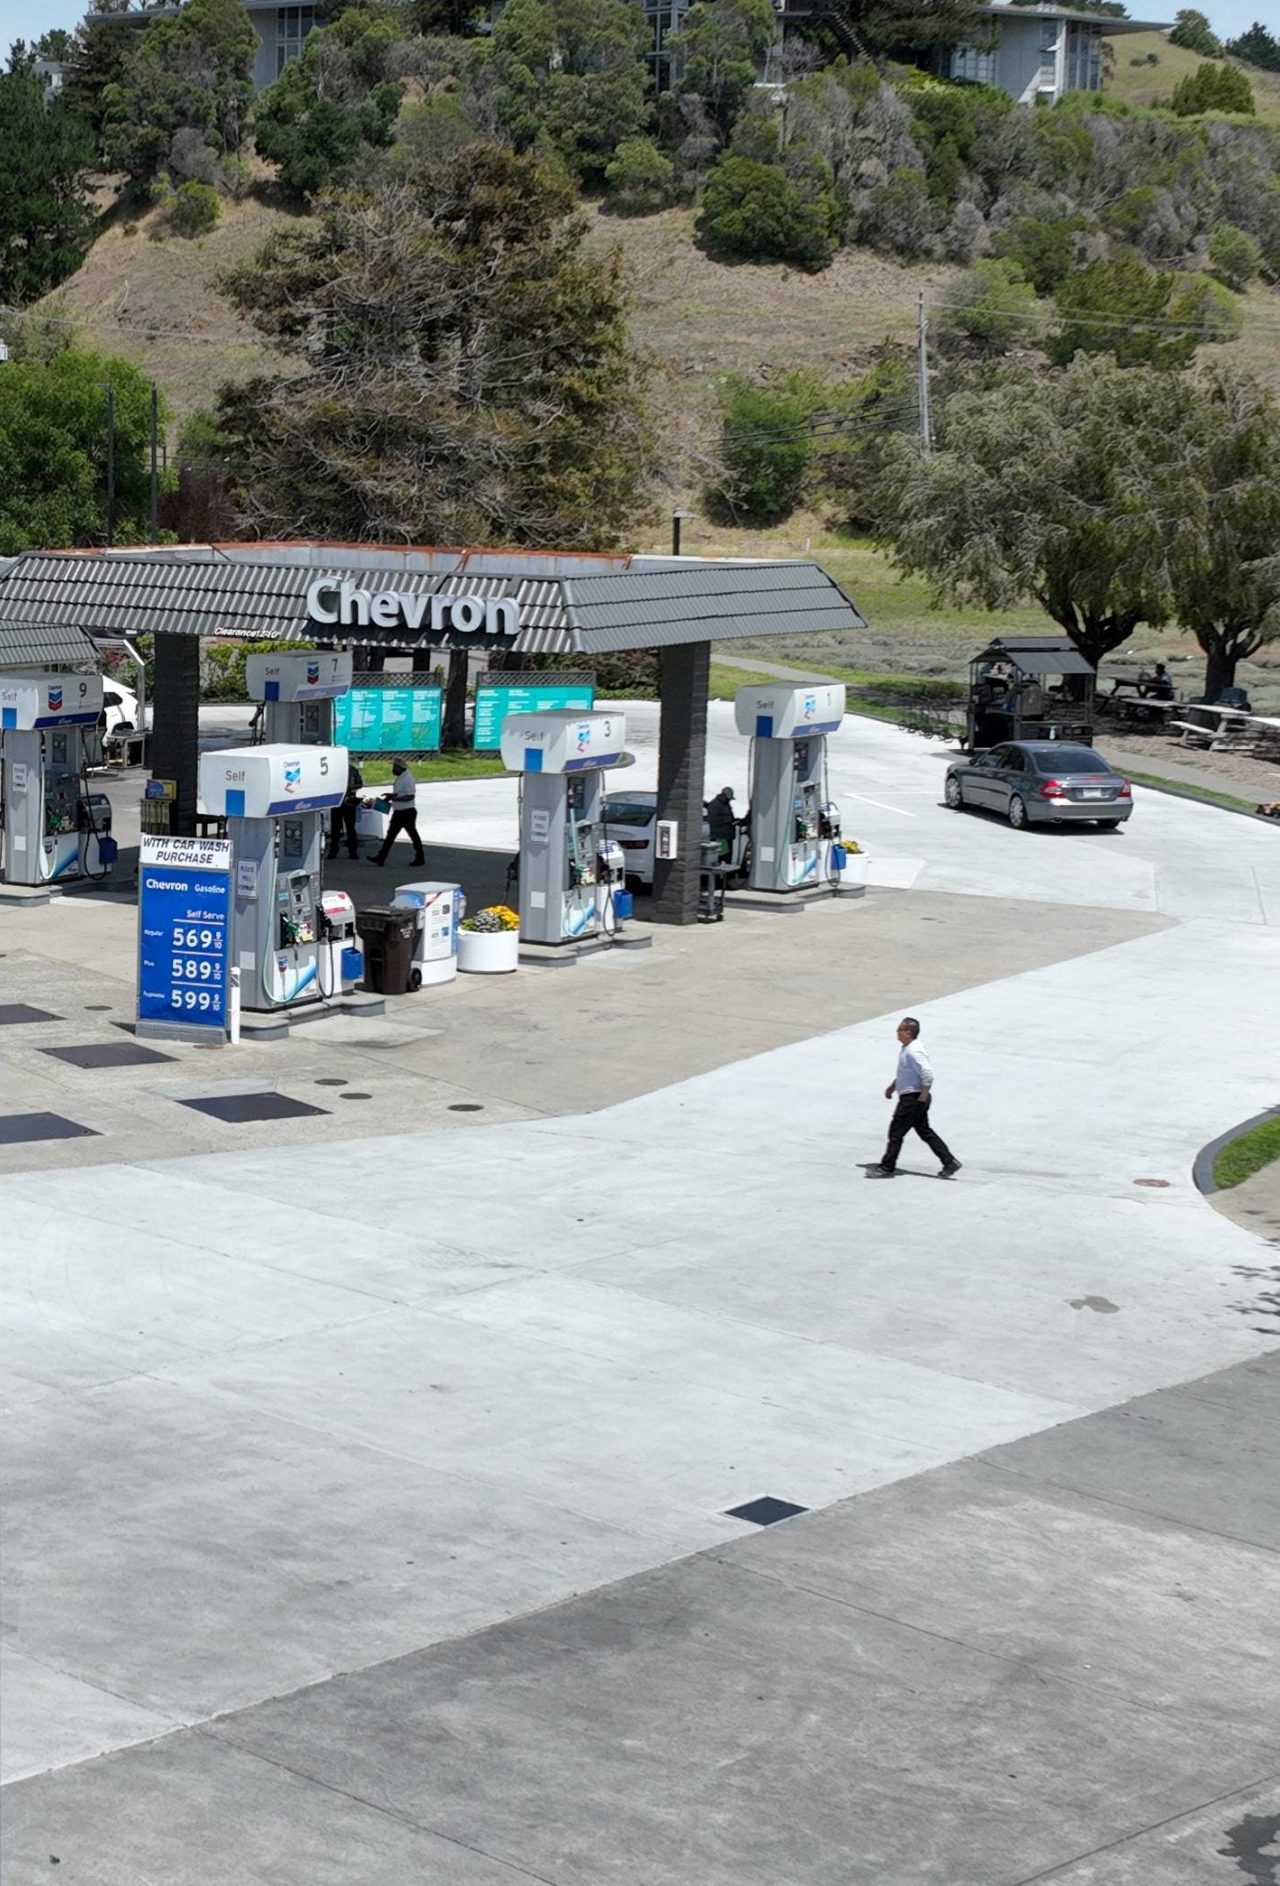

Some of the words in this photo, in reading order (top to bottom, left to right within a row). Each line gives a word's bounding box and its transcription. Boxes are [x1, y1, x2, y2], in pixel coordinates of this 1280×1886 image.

[306, 575, 520, 636] Chevron
[214, 627, 256, 637] Clearance
[265, 667, 280, 676] Self
[331, 658, 338, 672] 7
[1, 691, 18, 701] Self
[79, 682, 87, 698] 9
[525, 730, 544, 741] Self
[604, 720, 612, 737] 3
[320, 756, 329, 776] 5
[225, 770, 245, 782] Self
[143, 837, 170, 849] WITH
[172, 839, 195, 850] CAR
[199, 841, 229, 853] WASH
[156, 850, 214, 864] PURCHASE
[145, 878, 189, 892] Chevron
[194, 883, 226, 894] Gasoline
[186, 909, 201, 919] Self
[203, 911, 225, 920] Serve
[172, 928, 212, 949] 569
[171, 958, 211, 980] 589
[171, 989, 210, 1010] 599
